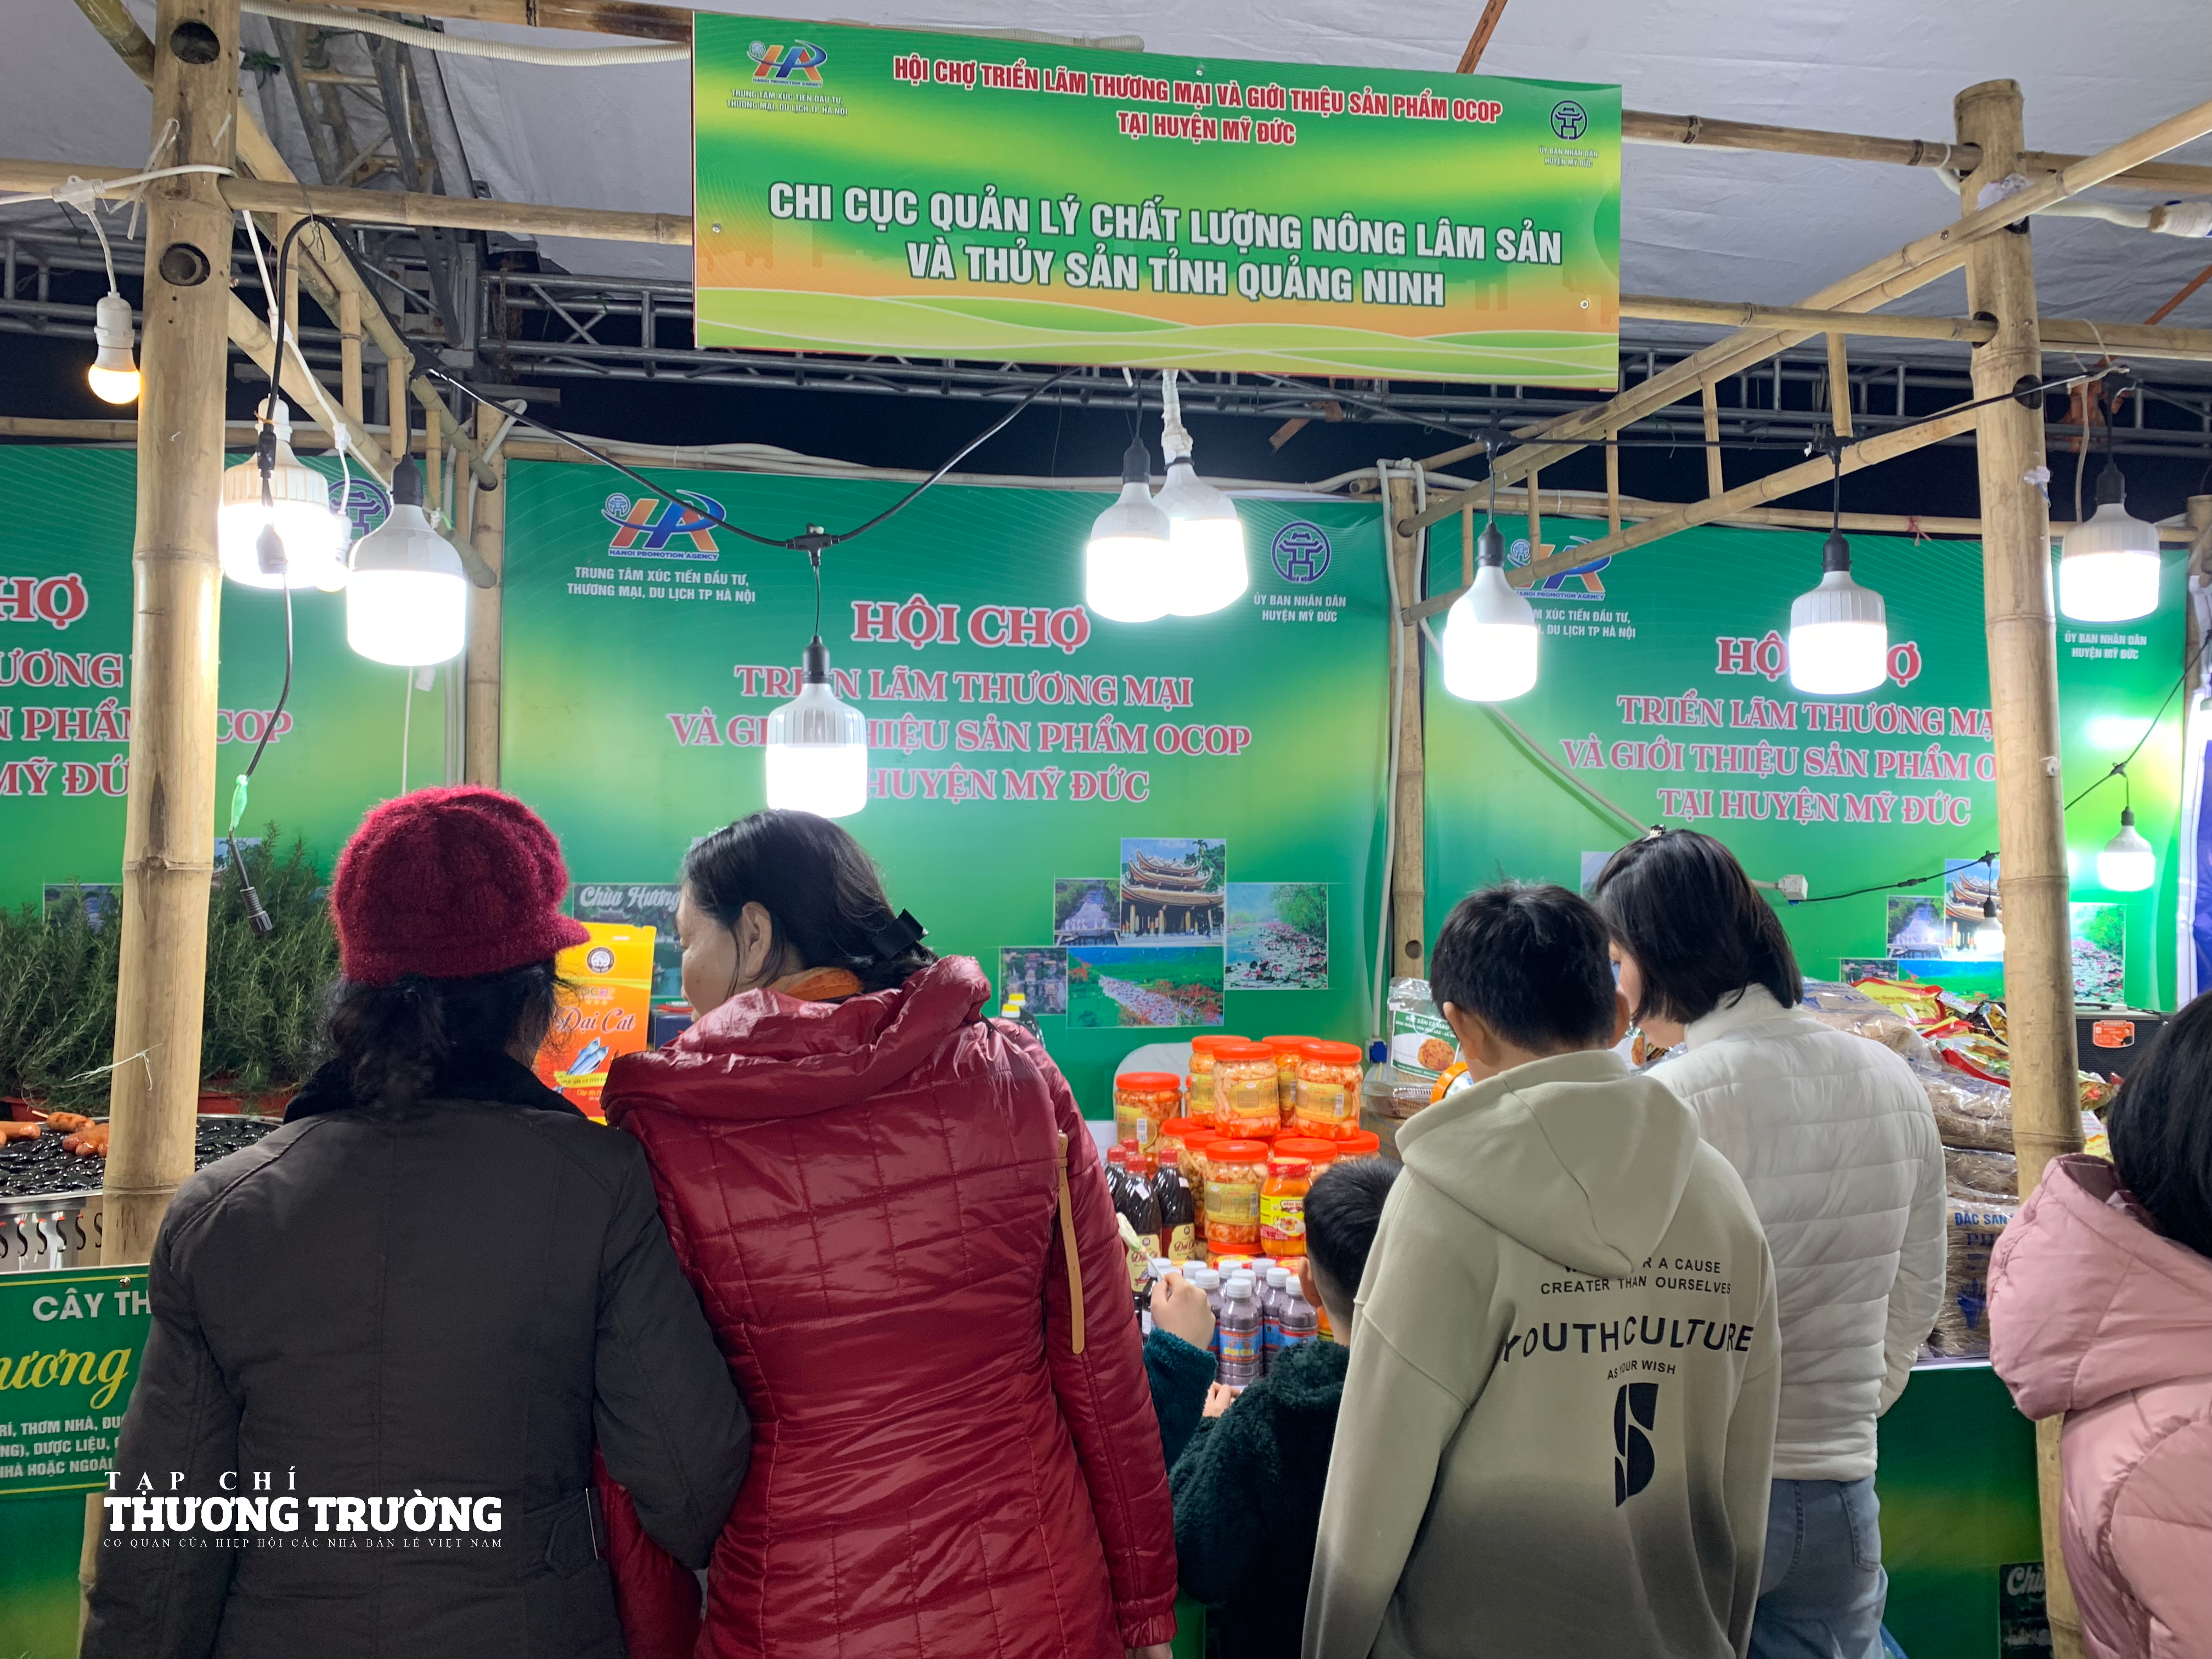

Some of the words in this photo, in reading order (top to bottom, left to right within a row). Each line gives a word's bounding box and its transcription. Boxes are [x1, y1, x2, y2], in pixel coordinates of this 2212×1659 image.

[731, 89, 757, 98] TRUNG
[894, 53, 929, 85] HỘI
[934, 60, 976, 89] CHỢ
[981, 59, 1039, 91] TRIỂN
[1043, 66, 1087, 95] LÃM
[1092, 74, 1169, 102] THƯƠNG
[1174, 81, 1211, 109] MẠI
[1216, 81, 1242, 107] VÀ
[1247, 83, 1285, 110] GIỚI
[1290, 86, 1344, 117] THIỆU
[1348, 87, 1388, 116] SẢN
[1393, 88, 1448, 120] PHẨM
[1453, 100, 1502, 123] OCOP
[1117, 111, 1148, 139] TẠI
[1154, 113, 1216, 143] HUYỆN
[1222, 117, 1251, 142] MỸ
[1257, 120, 1296, 145] ĐỨC
[1549, 147, 1563, 155] BAN
[770, 183, 833, 221] CHI
[843, 185, 918, 232] CỤC
[930, 184, 1030, 233] QUẢN
[1040, 194, 1081, 236] LÝ
[1091, 195, 1180, 242] CHẤT
[1189, 207, 1301, 255] LƯỢNG
[1312, 212, 1406, 256] NÔNG
[1415, 217, 1485, 259] LÂM
[1495, 218, 1562, 265] SẢN
[906, 236, 955, 280] VÀ
[964, 237, 1055, 285] THỦY
[1064, 241, 1139, 290] SẢN
[1148, 247, 1228, 295] TỈNH
[1237, 255, 1352, 302] QUẢNG
[1362, 268, 1445, 306] NINH
[575, 566, 614, 580] TRUNG
[618, 567, 643, 581] TÂM
[647, 568, 671, 583] XÚC
[675, 568, 701, 584] TIẾN
[704, 569, 727, 585] ĐẦU
[731, 574, 749, 587] TƯ,
[0, 573, 88, 629] HỢ
[567, 583, 614, 596] THƯƠNG
[619, 585, 645, 600] MẠI,
[649, 587, 665, 599] DU
[669, 588, 695, 601] LỊCH
[698, 589, 713, 600] TP
[715, 588, 732, 602] HÀ
[735, 589, 755, 605] NỘI
[1254, 591, 1267, 605] ỦY
[1269, 595, 1291, 606] BAN
[1294, 594, 1323, 607] NHÂN
[1325, 594, 1346, 607] DÂN
[851, 594, 959, 649] HỘI
[969, 605, 1090, 654] CHỢ
[1262, 608, 1295, 623] HUYỆN
[1299, 609, 1314, 622] MỸ
[1317, 610, 1337, 622] ĐỨC
[1546, 607, 1565, 620] XÚC
[1568, 608, 1590, 622] TIẾN
[1593, 609, 1612, 622] ĐẦU
[1616, 612, 1630, 624] TƯ,
[1547, 624, 1560, 635] DU
[1564, 625, 1585, 638] LỊCH
[1588, 626, 1600, 636] TP
[1602, 625, 1616, 637] HÀ
[1619, 626, 1636, 640] NỘI
[2064, 630, 2076, 643] ỦY
[2079, 634, 2098, 644] BAN
[2100, 633, 2126, 645] NHÂN
[2128, 633, 2147, 646] DÂN
[2072, 646, 2102, 660] HUYỆN
[2104, 647, 2119, 659] MỸ
[2120, 648, 2139, 659] ĐỨC
[0, 648, 123, 687] ƯƠNG
[735, 665, 860, 698] TRIN
[870, 665, 947, 702] LÃM
[953, 670, 1117, 706] THƯƠNG
[1123, 676, 1193, 712] MẠI
[21, 696, 130, 741] PHẨ
[1618, 689, 1723, 727] TRIỂN
[1730, 696, 1797, 729] LÃM
[1803, 702, 1944, 735] THƯƠNG
[1950, 707, 1993, 741] MẠ
[668, 708, 723, 746] VÀ
[957, 713, 1030, 752] SẢN
[1037, 713, 1148, 753] PHẨM
[1154, 724, 1250, 755] OCOP
[1560, 733, 1606, 769] VÀ
[1611, 735, 1685, 771] GIỚI
[1690, 740, 1798, 778] THIỆU
[1805, 741, 1868, 776] SẢN
[1876, 743, 1970, 780] PHẨM
[1004, 766, 1064, 800] MỸ
[1070, 764, 1149, 802] ĐỨC
[1658, 789, 1713, 821] TẠI
[1721, 787, 1838, 825] HUYỆN
[1846, 792, 1897, 821] MỸ
[1903, 791, 1970, 825] ĐỨC
[580, 887, 623, 907] Chùa
[628, 887, 681, 912] Hương
[1658, 1257, 1668, 1269] A
[1675, 1259, 1720, 1273] CAUSE
[1617, 1276, 1646, 1289] THAN
[1656, 1277, 1731, 1294] OURSELVES
[33, 1287, 104, 1322] CÂY
[1503, 1315, 1753, 1363] YOUTHCULTURE
[1607, 1368, 1618, 1380] AS
[1641, 1359, 1675, 1374] WISH
[20, 1420, 60, 1436] THƠM
[65, 1416, 98, 1432] NHÀ,
[33, 1440, 71, 1457] DƯỢC
[76, 1436, 110, 1454] LIỆU,
[27, 1459, 65, 1477] HOẶC
